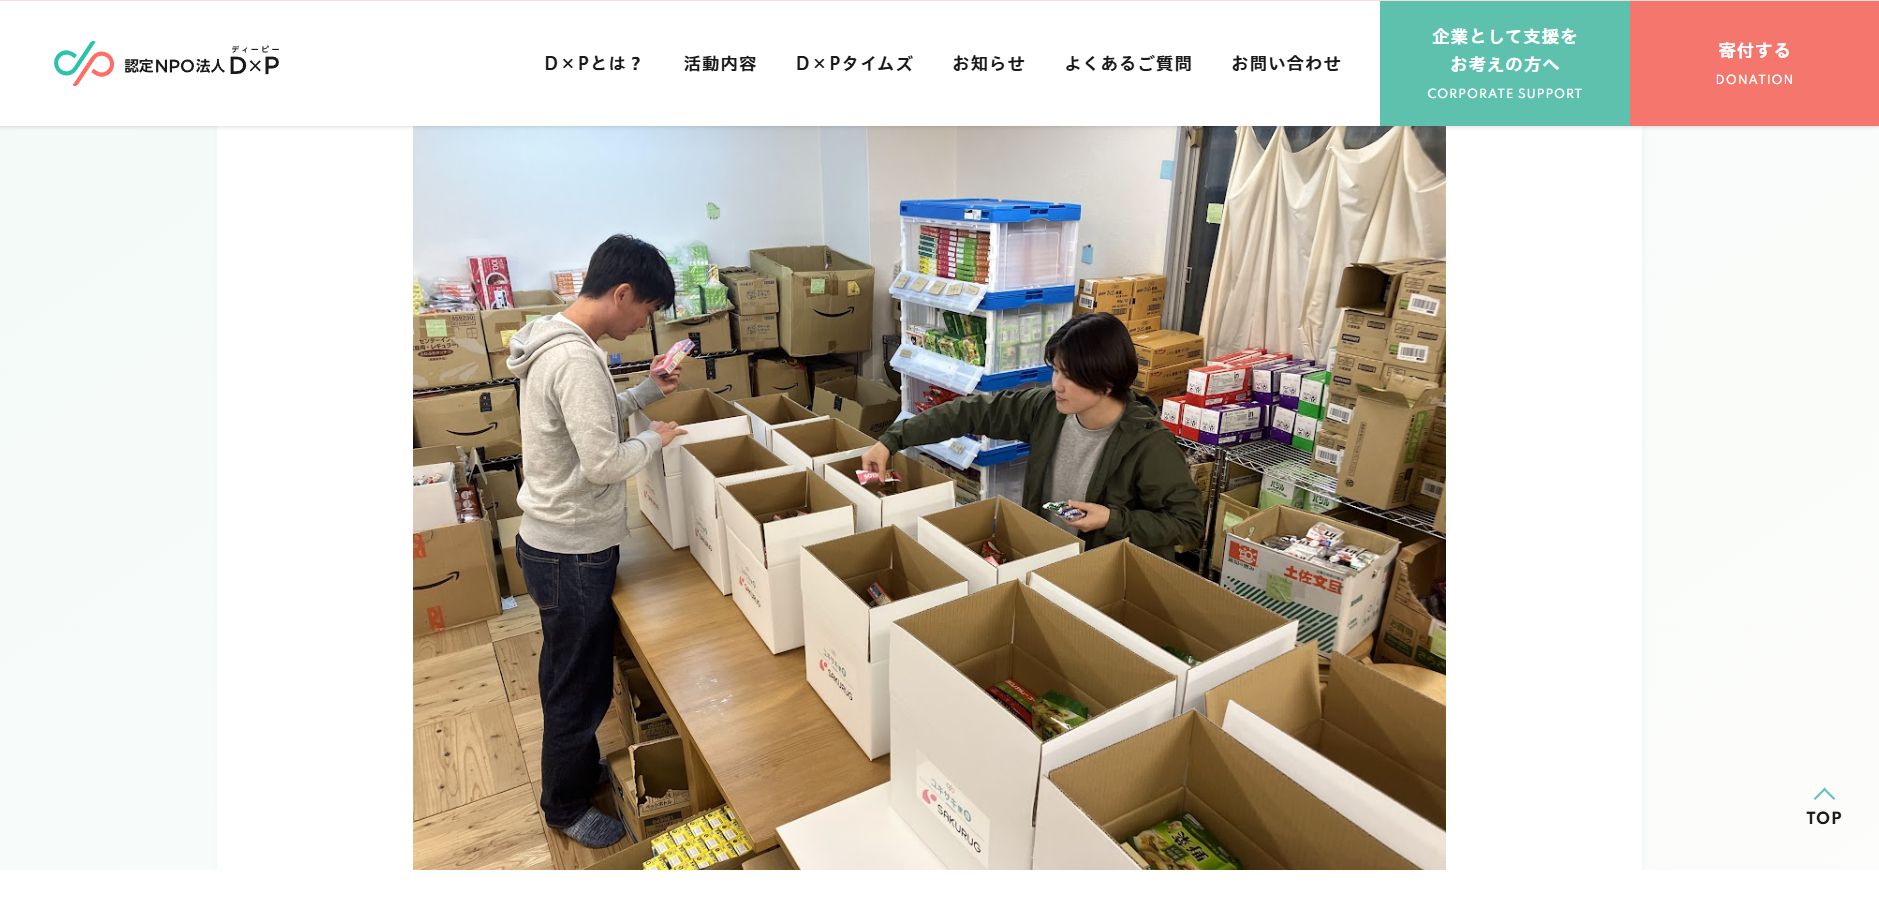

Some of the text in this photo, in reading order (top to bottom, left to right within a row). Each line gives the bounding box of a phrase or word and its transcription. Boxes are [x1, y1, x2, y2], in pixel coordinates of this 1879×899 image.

[1270, 481, 1285, 491] バジル
[1312, 494, 1330, 507] バジル
[1284, 565, 1343, 595] 土佐文旦
[937, 804, 982, 853] SAKURUG
